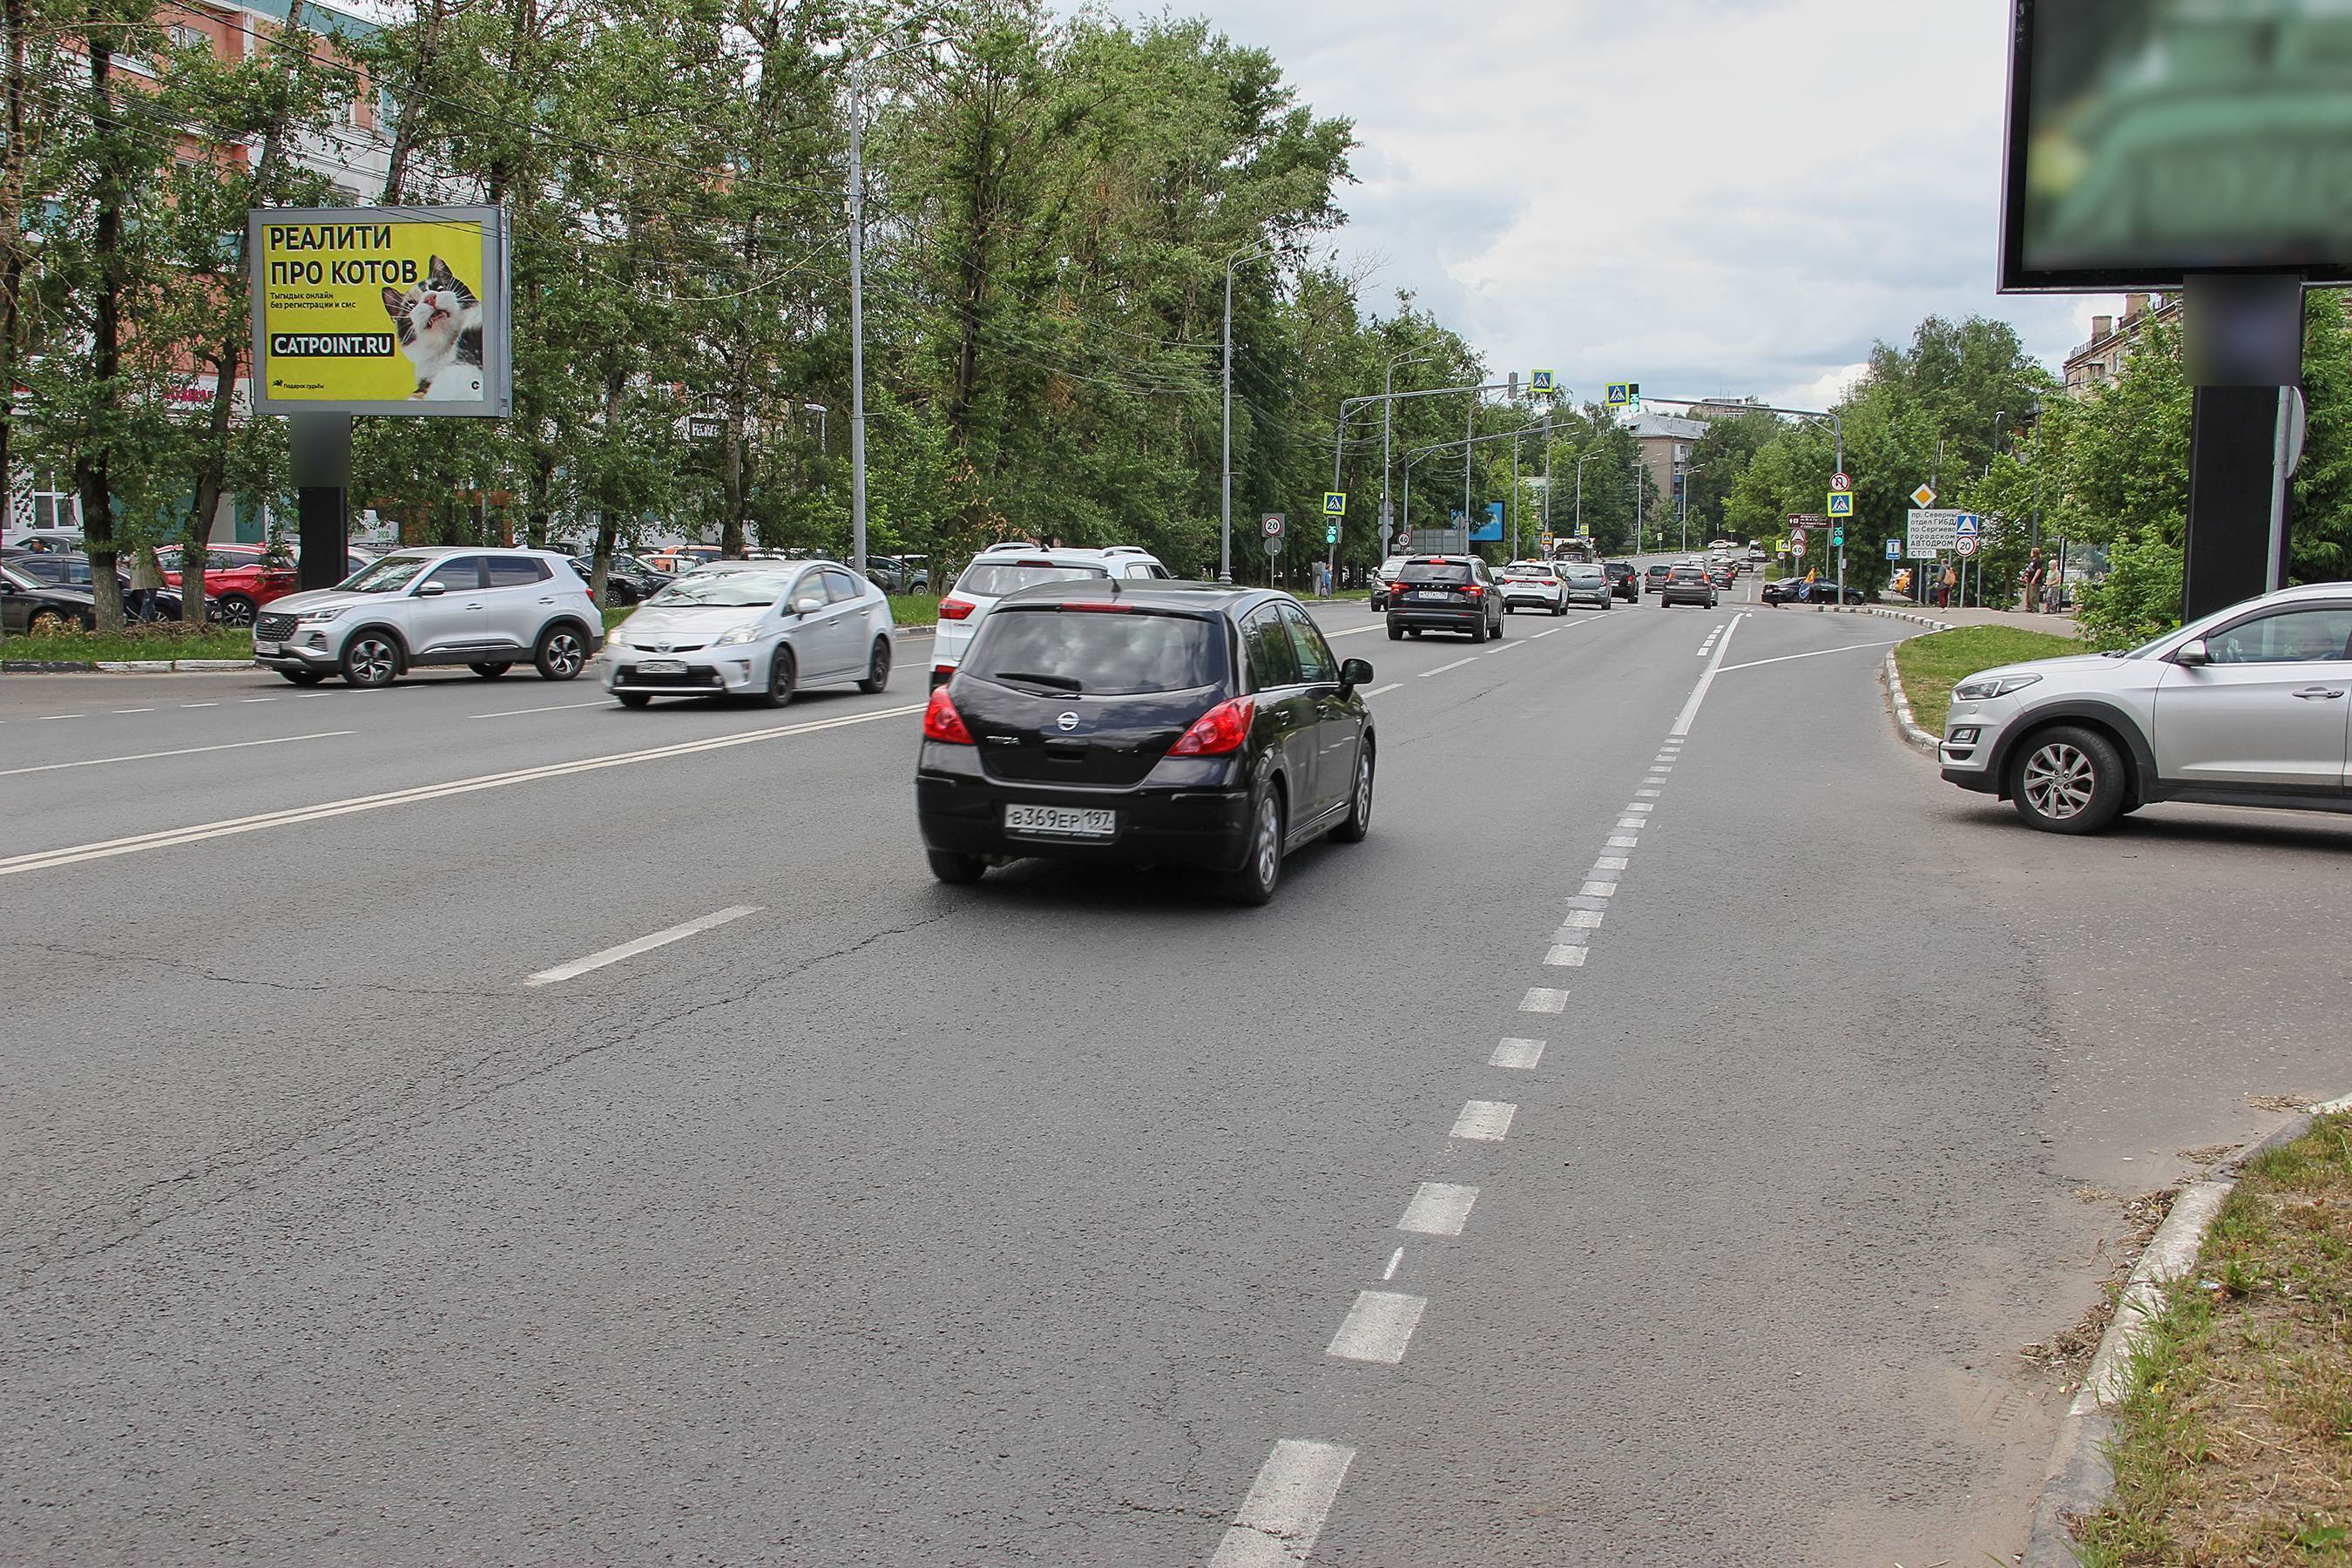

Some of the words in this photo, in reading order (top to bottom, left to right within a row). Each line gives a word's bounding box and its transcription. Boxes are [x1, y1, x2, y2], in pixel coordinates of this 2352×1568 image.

[269, 225, 391, 250] РЕАЛИТИ
[271, 260, 323, 285] ПРО
[331, 260, 418, 284] КОТОВ
[306, 291, 334, 300] онлайн
[274, 336, 391, 354] CATPOINT.RU
[1834, 526, 1843, 536] 26
